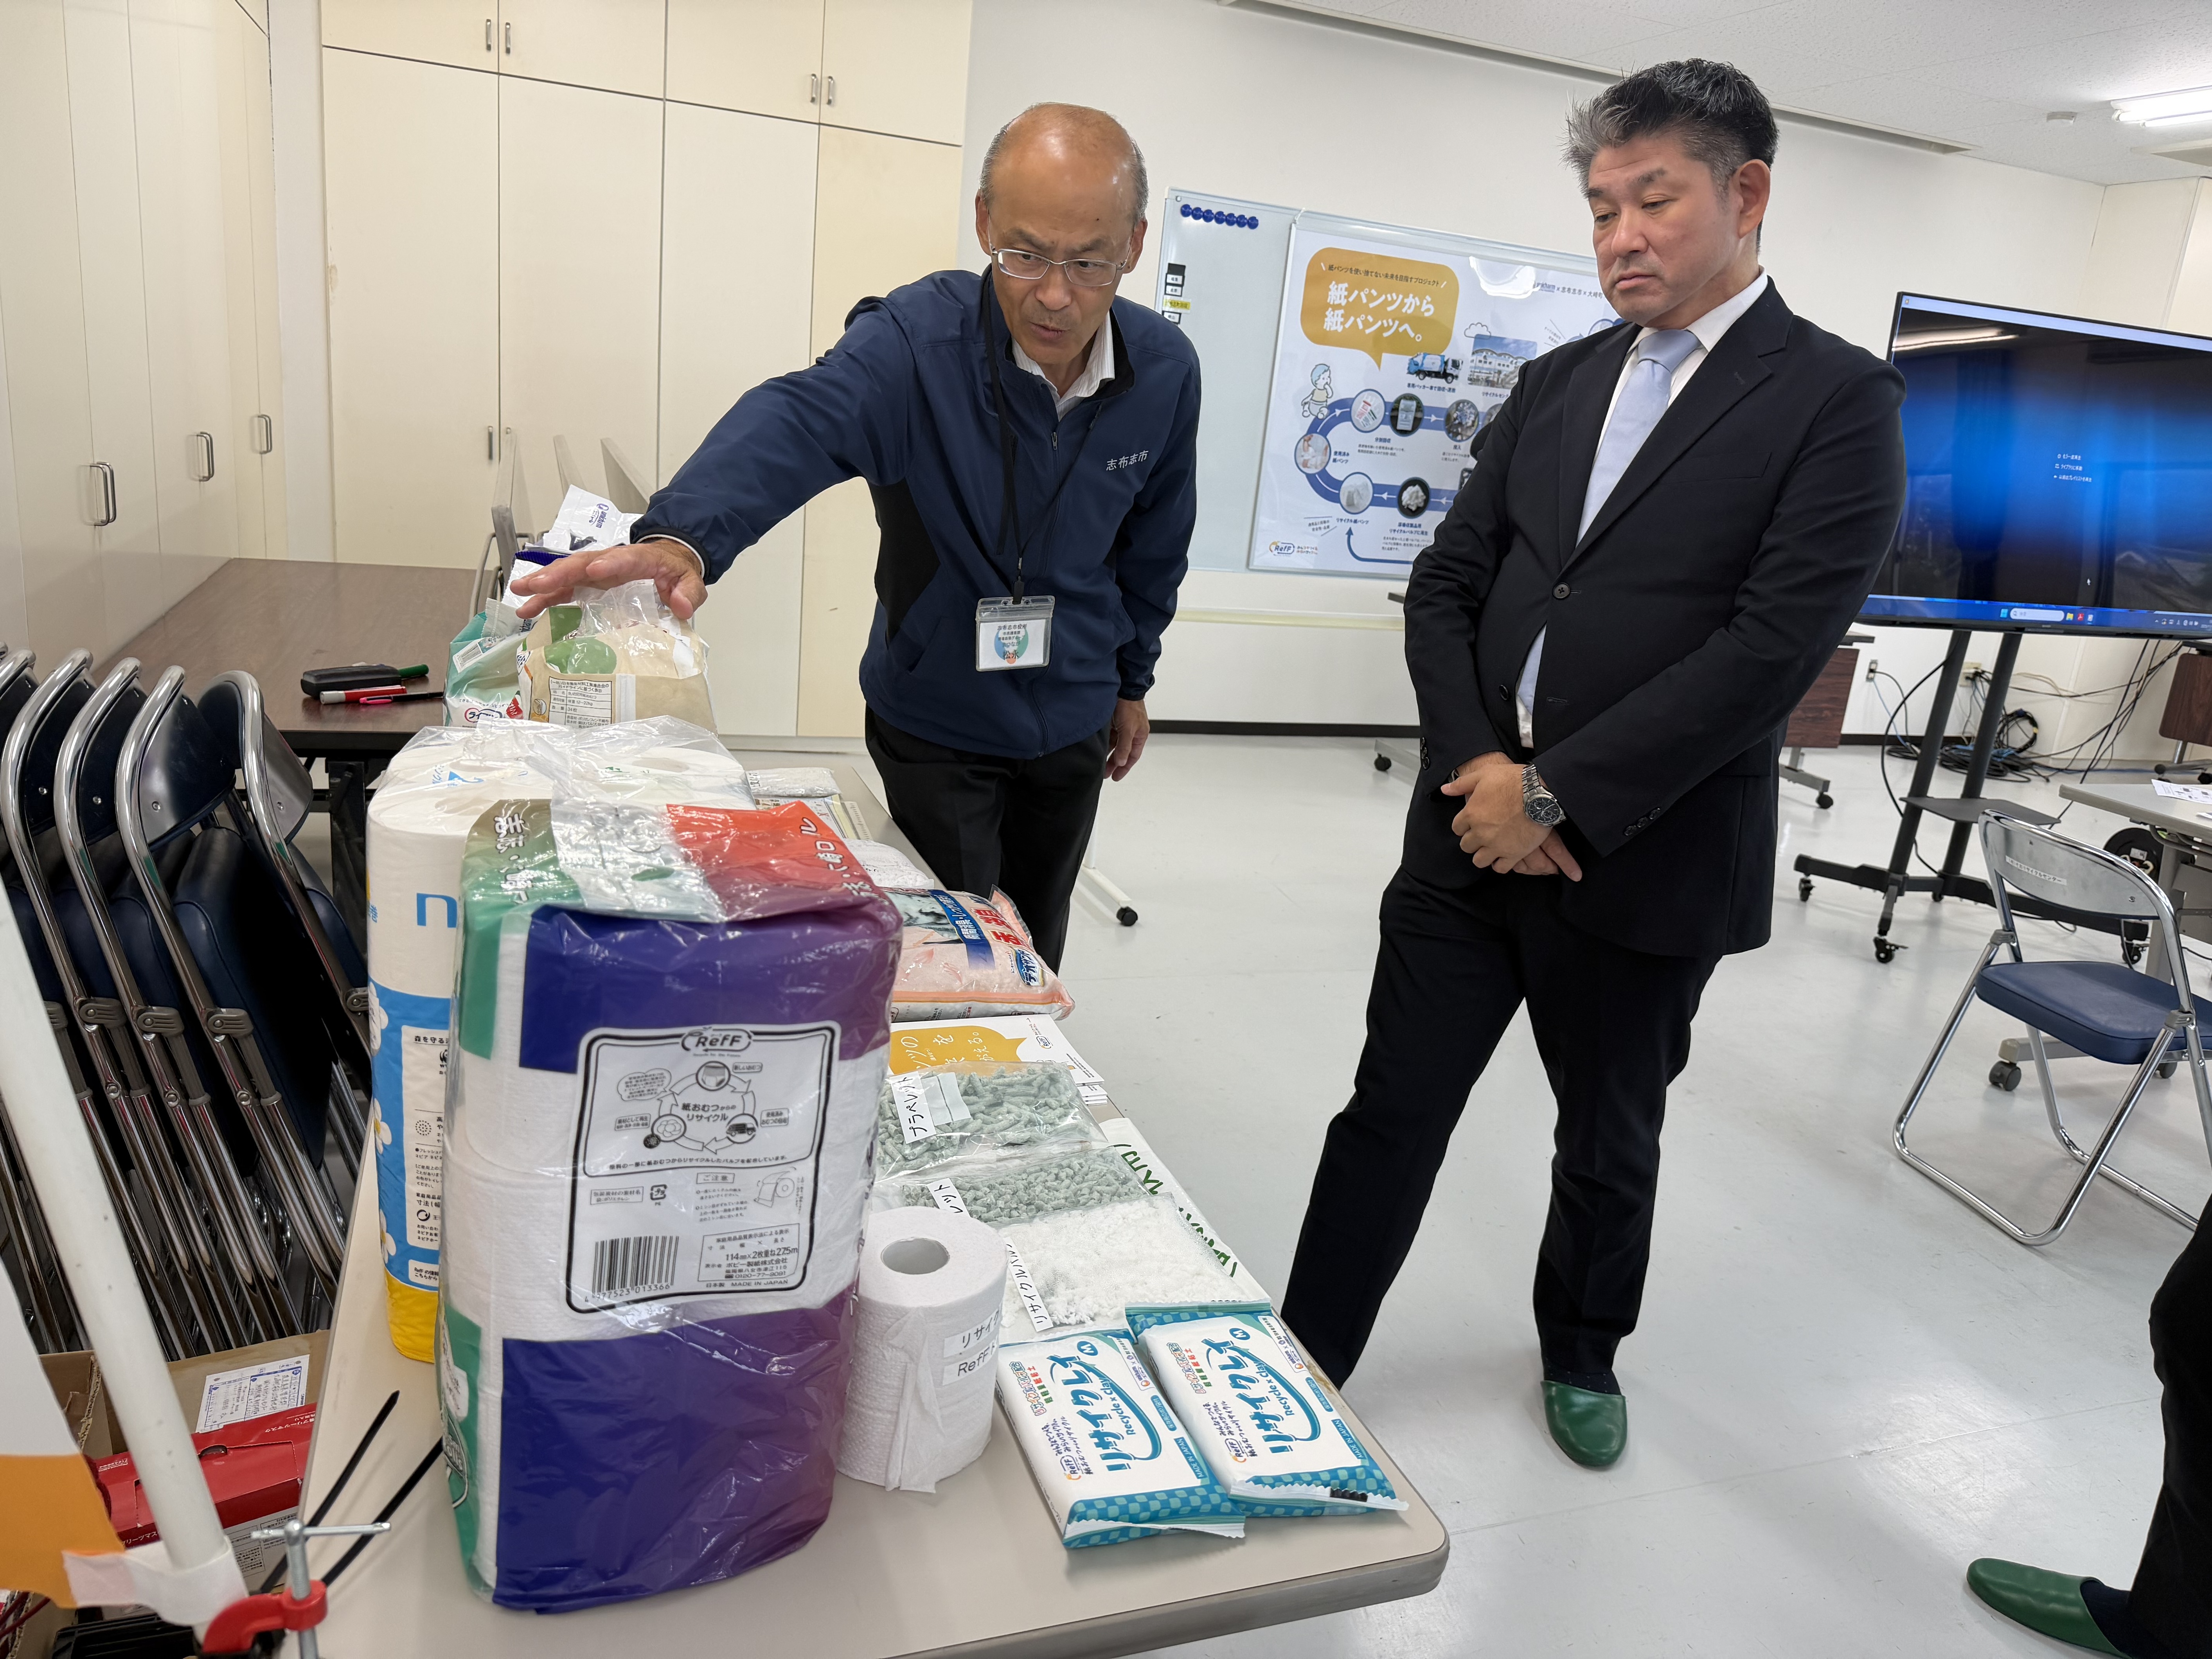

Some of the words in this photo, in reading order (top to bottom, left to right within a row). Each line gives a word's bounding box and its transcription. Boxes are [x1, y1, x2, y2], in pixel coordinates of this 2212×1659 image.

[1327, 281, 1435, 317] 紙パンツから
[1324, 307, 1423, 342] 紙パンツへ。
[1106, 450, 1149, 471] 志布志市
[682, 1103, 736, 1112] 紙おむつからの
[687, 1113, 728, 1122] リサイクル
[1237, 1331, 1246, 1339] M
[1084, 1345, 1095, 1355] M
[1201, 1337, 1294, 1454] リサイクレイ
[1268, 1386, 1294, 1416] Recycle
[1047, 1355, 1132, 1472] リサイクレイ
[1111, 1401, 1136, 1436] Recycle
[1335, 1420, 1348, 1436] JAPAN
[1177, 1439, 1190, 1454] JAPAN
[1350, 1442, 1365, 1459] MADE
[1190, 1460, 1204, 1478] MADE
